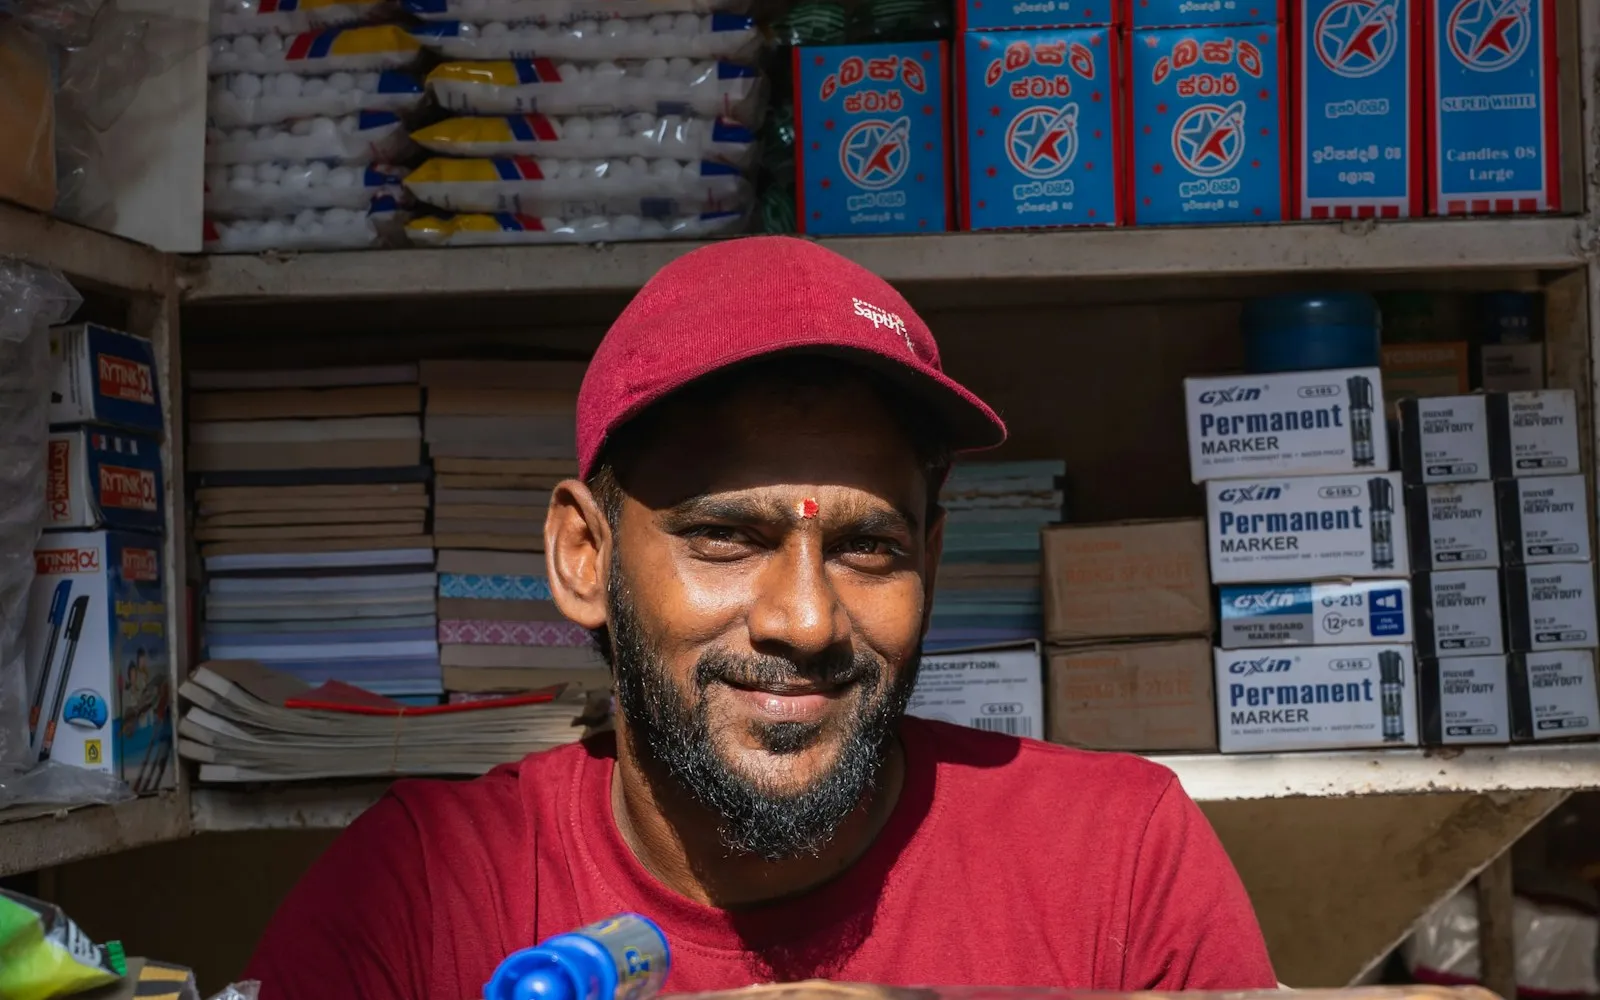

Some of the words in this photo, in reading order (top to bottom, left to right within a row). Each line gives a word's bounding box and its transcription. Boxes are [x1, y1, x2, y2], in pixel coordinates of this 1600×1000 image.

[1441, 96, 1490, 112] SUPER
[1490, 93, 1536, 110] WHITE
[1446, 147, 1509, 161] Candles
[1469, 167, 1515, 183] Large
[100, 359, 138, 387] RYTINK
[1200, 404, 1343, 437] Permanent
[1513, 417, 1540, 427] HEAVY
[1541, 416, 1564, 426] DUTY
[1423, 424, 1450, 434] HEAVY
[1451, 423, 1474, 433] DUTY
[1201, 436, 1280, 455] MARKER
[54, 443, 68, 498] RYTINK
[100, 468, 141, 495] RYTINK
[1432, 510, 1459, 520] HEAVY
[1460, 509, 1482, 519] DUTY
[1523, 503, 1550, 514] HEAVY
[1552, 502, 1574, 513] DUTY
[1219, 506, 1363, 535] Permanent
[1220, 536, 1299, 553] MARKER
[37, 552, 77, 566] TINK
[1322, 594, 1363, 607] G-213
[1436, 597, 1463, 607] HEAVY
[1464, 596, 1486, 606] DUTY
[1531, 590, 1558, 601] HEAVY
[1559, 589, 1582, 599] DUTY
[1233, 623, 1264, 632] WHITE
[1269, 622, 1303, 631] BOARD
[1248, 631, 1290, 640] MARKER
[1443, 684, 1470, 694] HEAVY
[1471, 683, 1494, 693] DUTY
[1532, 677, 1559, 688] HEAVY
[1560, 676, 1583, 686] DUTY
[1230, 678, 1373, 707] Permanent
[80, 694, 96, 707] 50
[1230, 709, 1309, 725] MARKER
